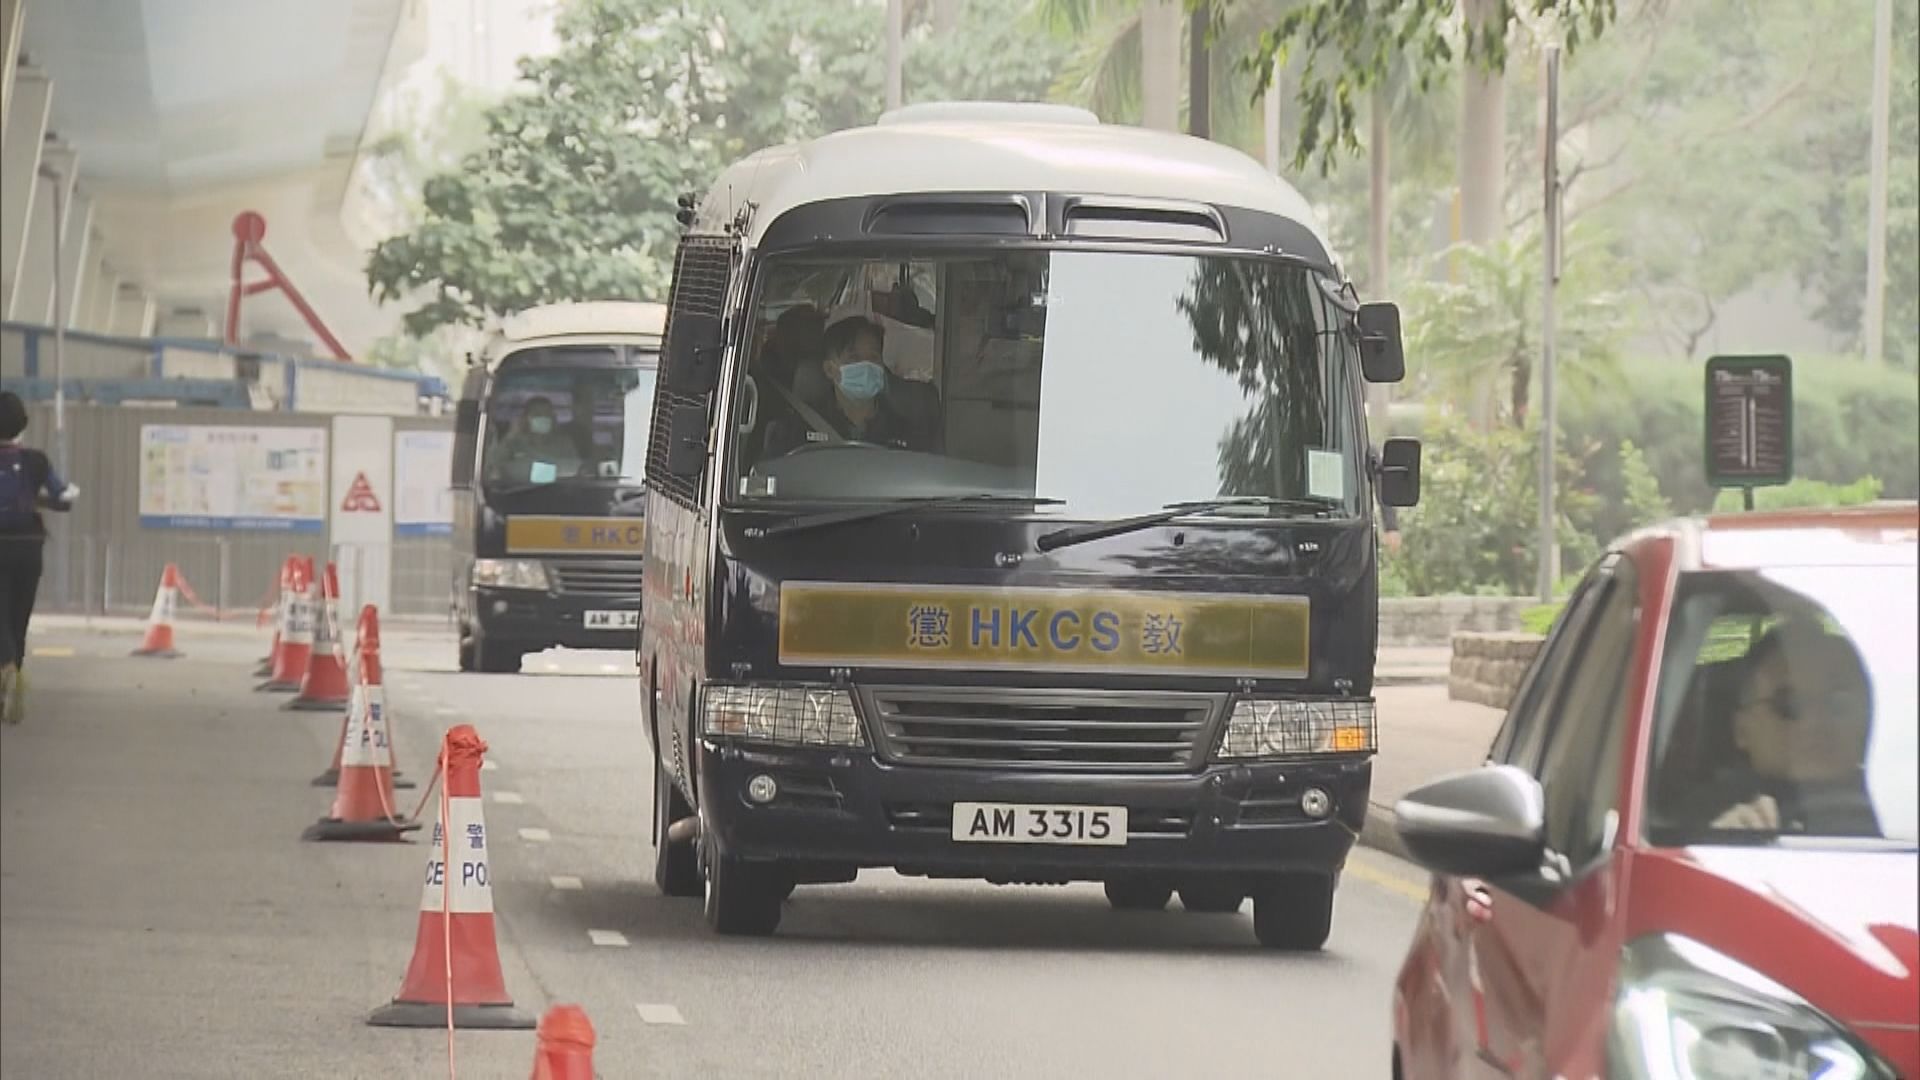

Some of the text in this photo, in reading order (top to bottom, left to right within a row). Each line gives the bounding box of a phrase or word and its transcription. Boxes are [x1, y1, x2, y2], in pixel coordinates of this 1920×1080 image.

[590, 613, 610, 625] AM
[909, 606, 950, 647] 懲
[970, 607, 1121, 651] HKCS
[466, 823, 484, 849] 警
[969, 808, 1111, 840] AM 3315
[462, 861, 492, 887] PO
